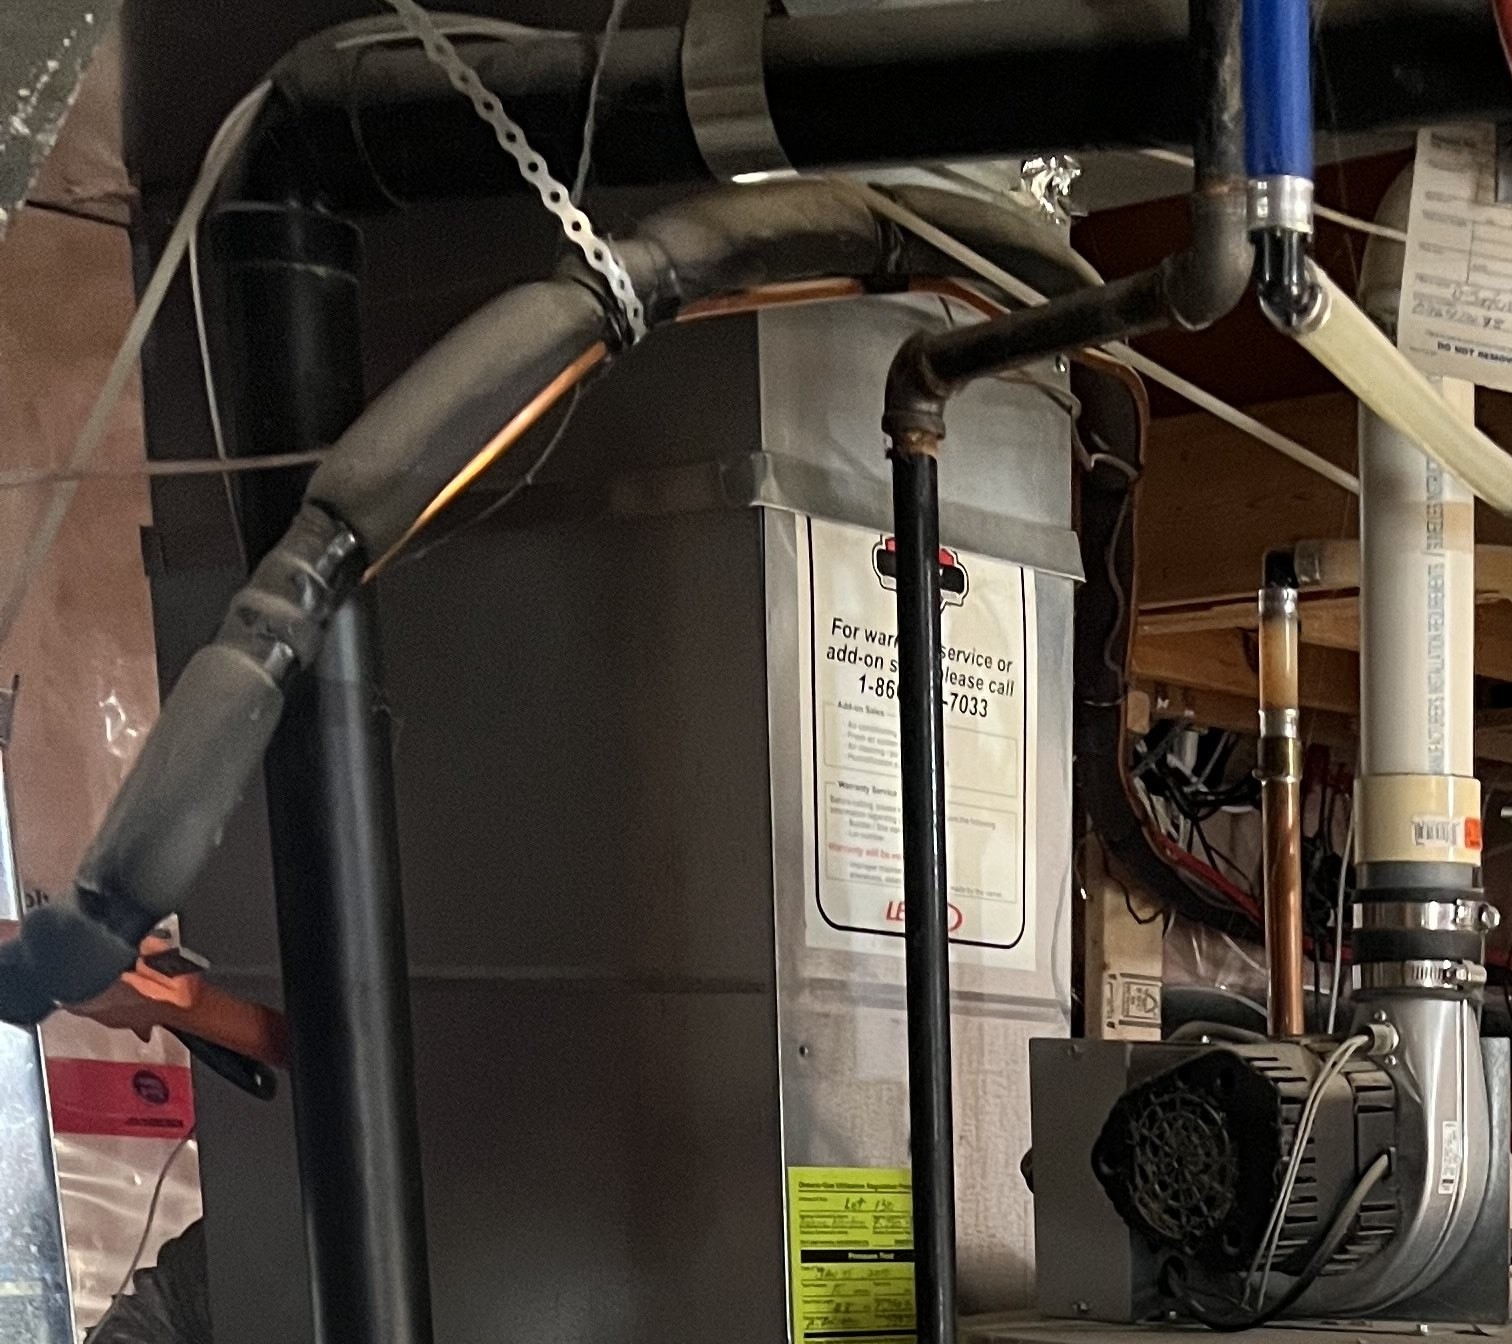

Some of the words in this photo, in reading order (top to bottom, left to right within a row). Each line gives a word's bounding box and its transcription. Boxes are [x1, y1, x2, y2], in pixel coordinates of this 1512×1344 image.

[1454, 344, 1475, 357] NOT
[826, 644, 884, 670] add-on
[831, 617, 860, 640] For
[940, 643, 993, 670] service
[997, 658, 1013, 673] or
[942, 666, 984, 691] lease
[988, 679, 1015, 697] call
